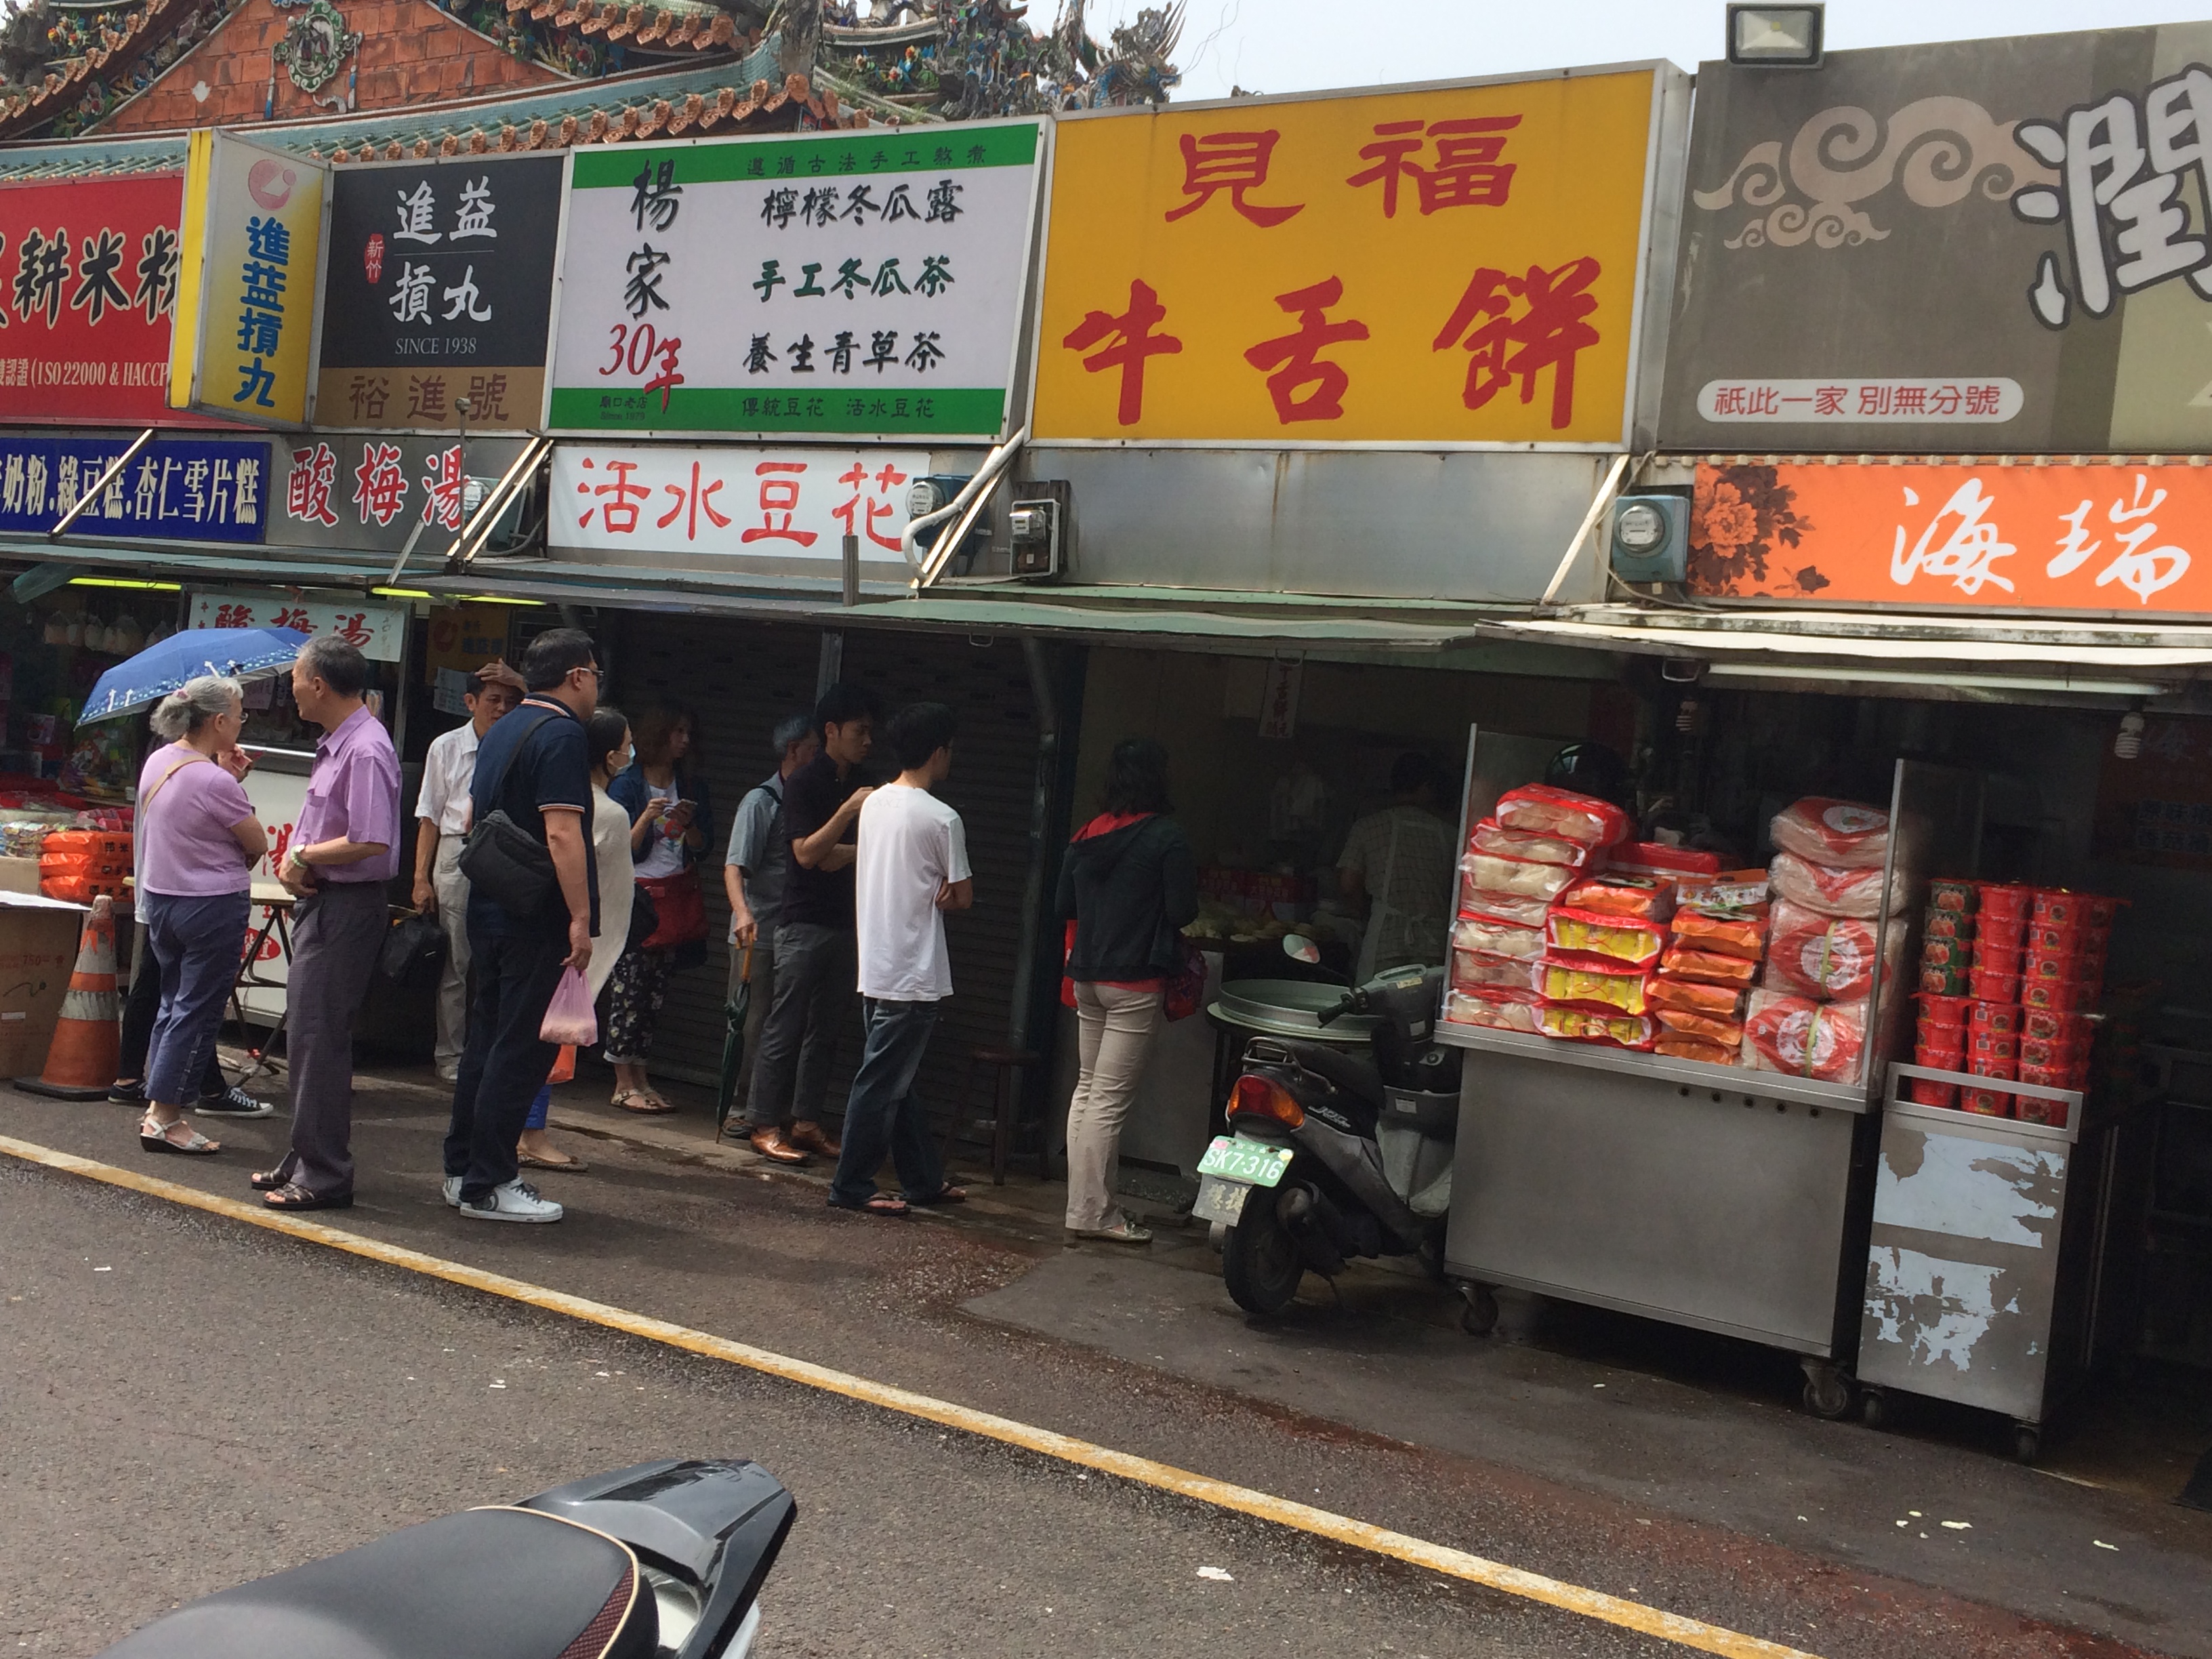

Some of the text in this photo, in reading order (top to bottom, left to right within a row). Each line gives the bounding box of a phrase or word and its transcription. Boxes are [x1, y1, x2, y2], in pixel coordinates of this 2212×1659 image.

[1164, 114, 1523, 228] 見福
[393, 176, 497, 245] 進益
[760, 179, 964, 230] 檸檬冬瓜露
[366, 239, 384, 279] 新竹
[623, 159, 683, 320] 楊家
[0, 226, 179, 330] 耕米粉
[752, 255, 956, 303] 手工冬瓜茶
[395, 337, 477, 354] SINCE 1938
[743, 331, 947, 375] 養生青草茶
[1062, 255, 1601, 430] 牛舌餅
[348, 373, 510, 422] 裕進號
[742, 397, 935, 418] 傳統豆花 活水豆花
[287, 443, 470, 532] 酸梅湯
[576, 457, 907, 552] 活水豆花
